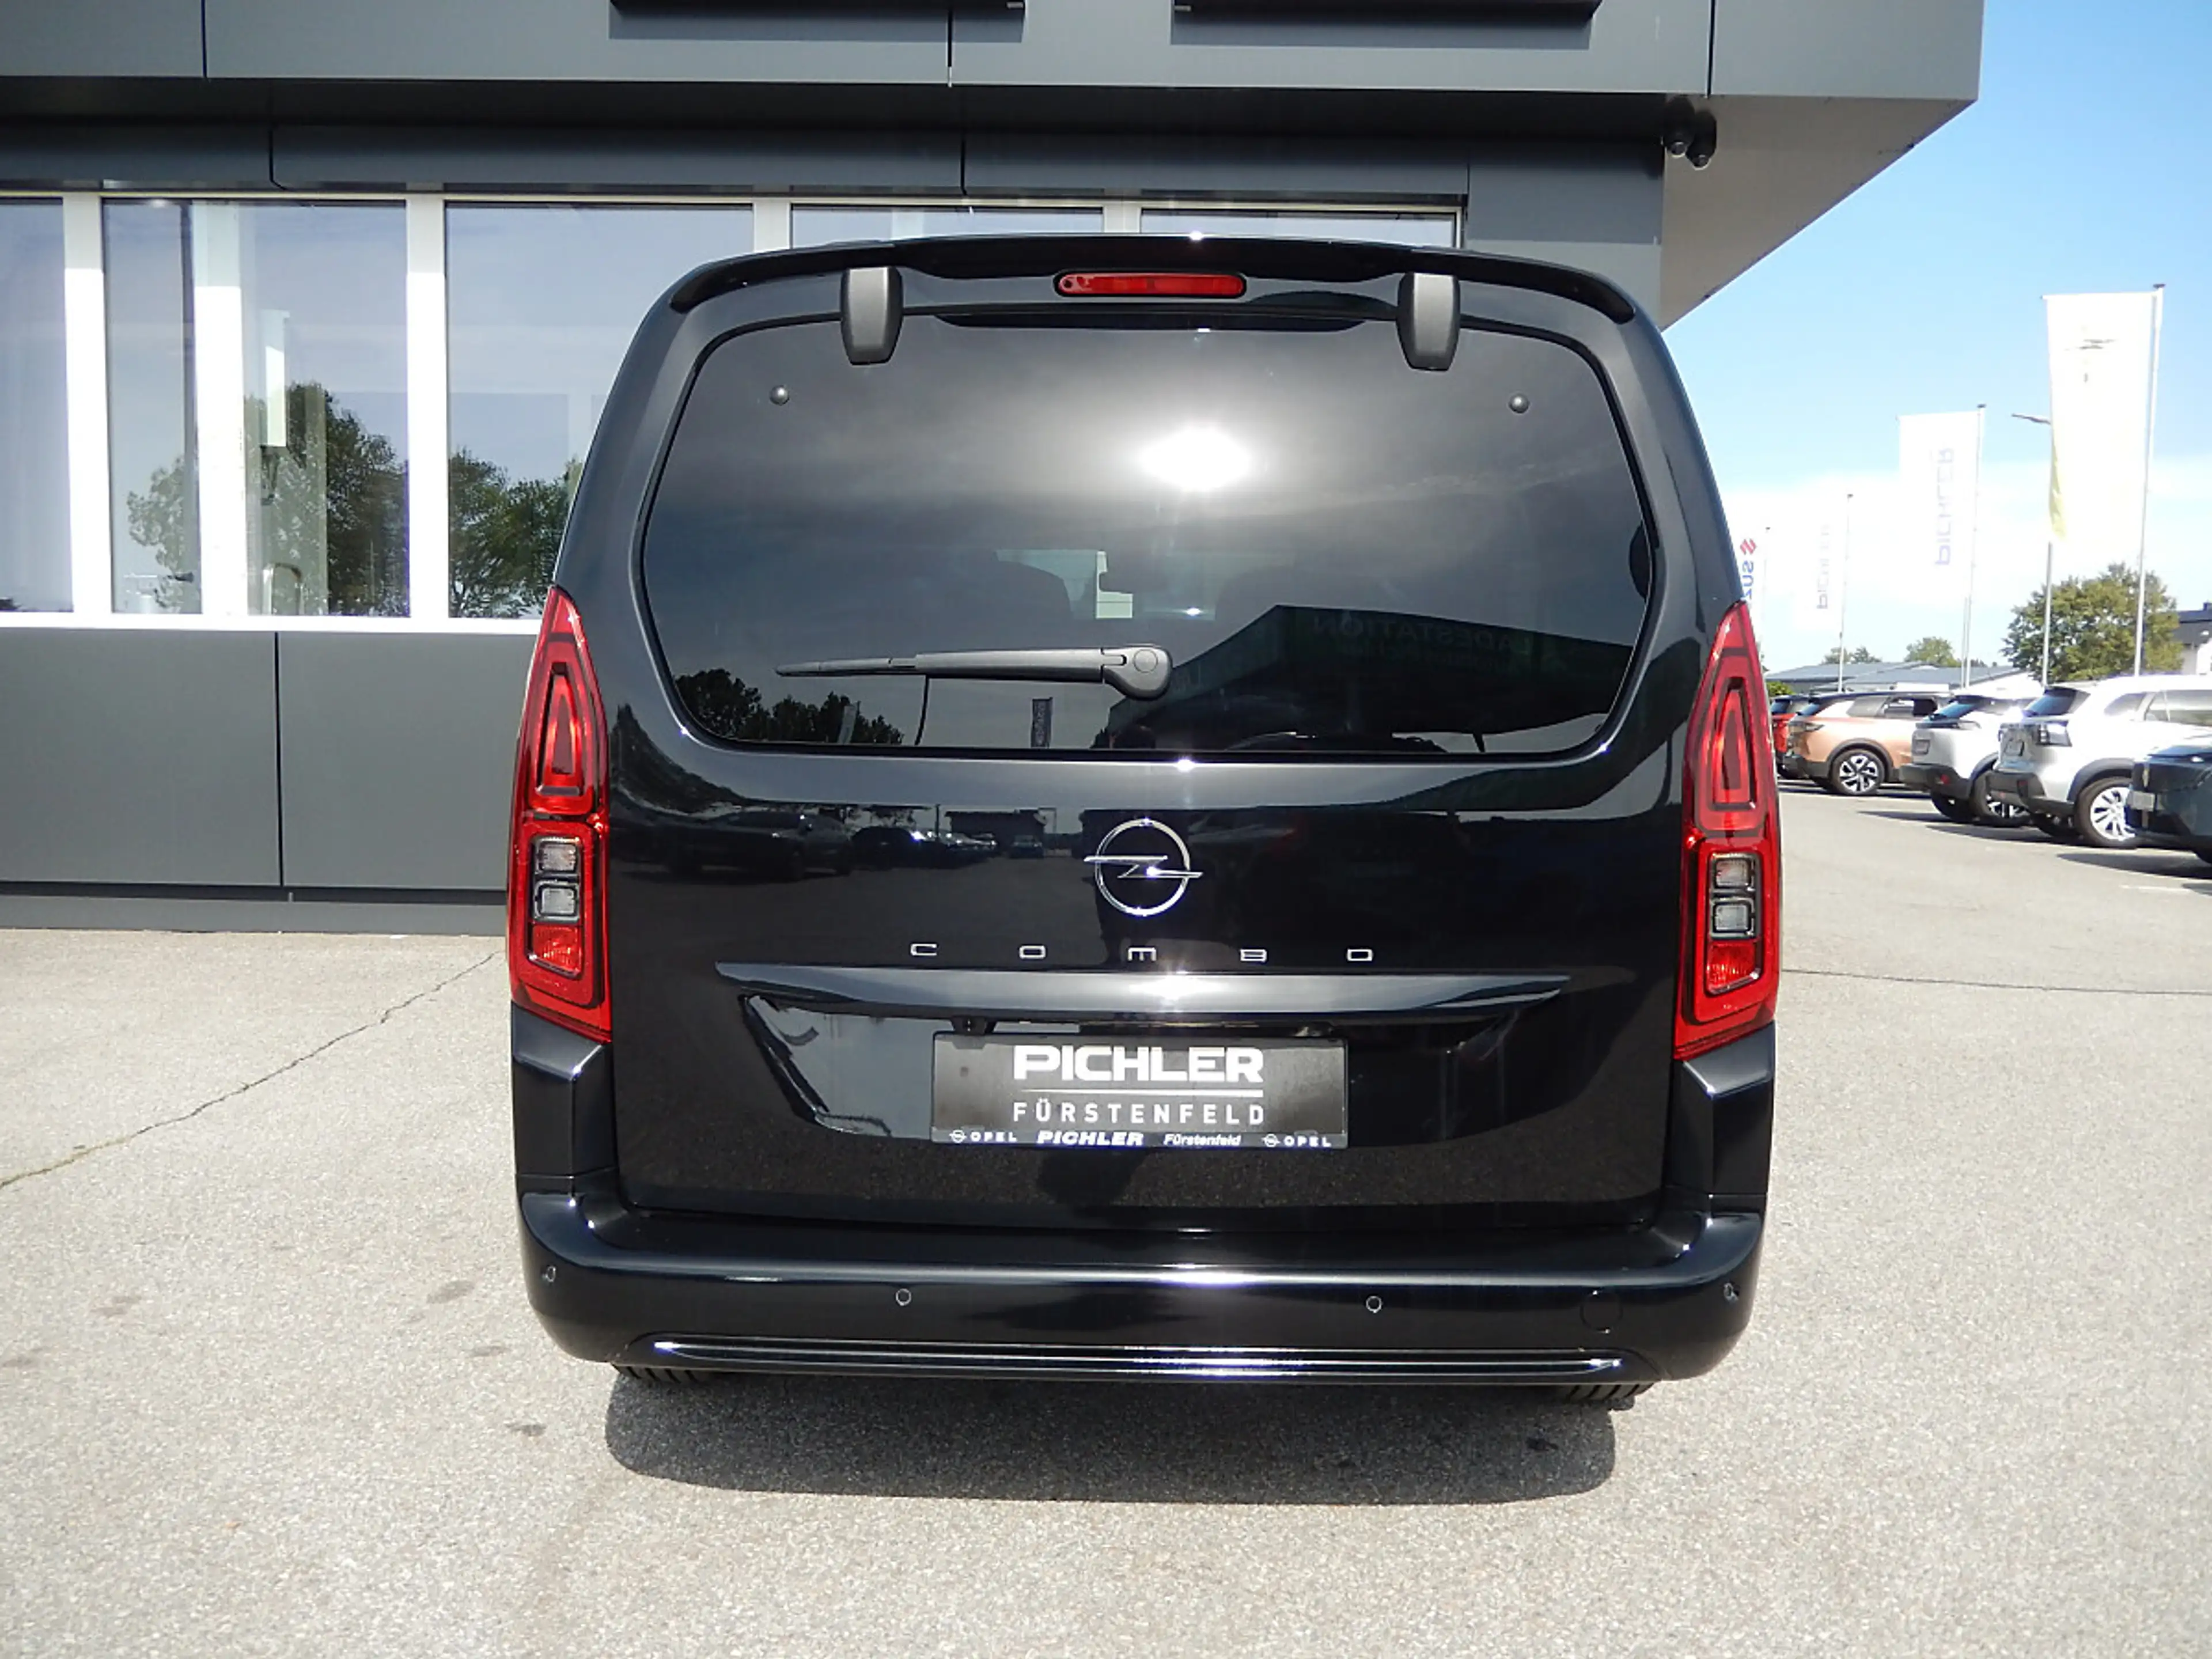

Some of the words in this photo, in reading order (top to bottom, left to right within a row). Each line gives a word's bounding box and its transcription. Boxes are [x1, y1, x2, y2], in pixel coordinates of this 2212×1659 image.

[910, 943, 1374, 963] COMBO
[1013, 1044, 1264, 1084] PICHLER
[1013, 1098, 1265, 1126] FÜRSTENFELD
[969, 1131, 1018, 1142] OPEL
[1036, 1130, 1144, 1146] PICHLER
[1162, 1133, 1241, 1147] Fürstenfeld
[1283, 1135, 1332, 1147] OPEL
